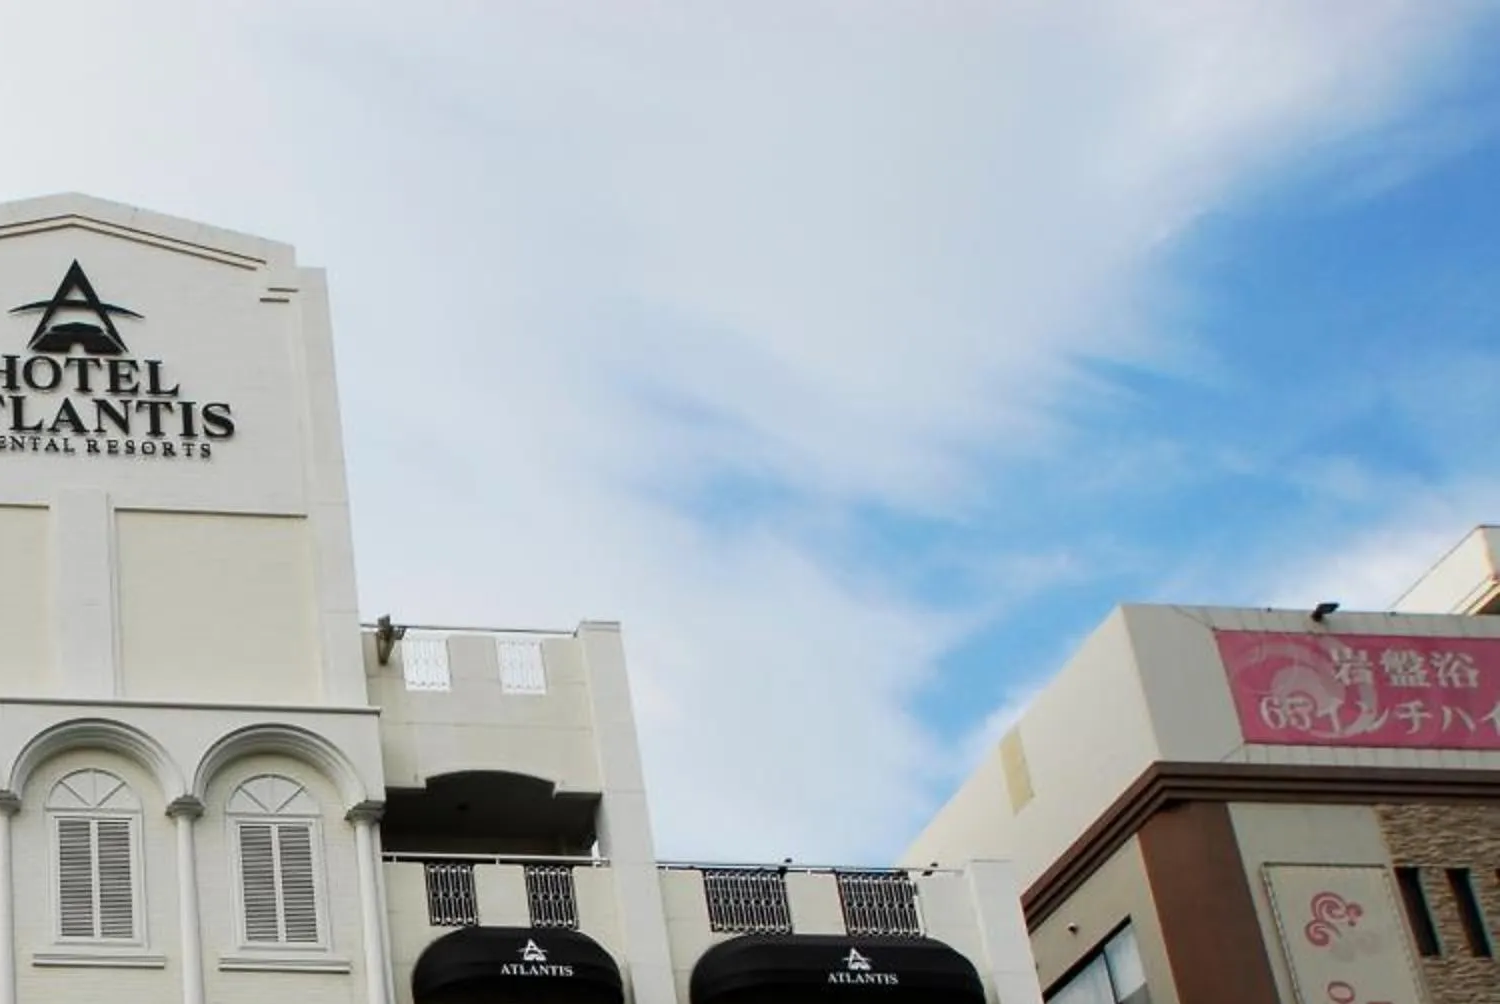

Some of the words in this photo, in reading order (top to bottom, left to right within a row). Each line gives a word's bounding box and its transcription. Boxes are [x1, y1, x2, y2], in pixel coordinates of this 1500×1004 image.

[87, 438, 211, 459] RESORTS
[1332, 647, 1479, 688] 岩盤浴
[501, 963, 574, 977] ATLANTIS
[828, 972, 899, 986] ATLANTIS
